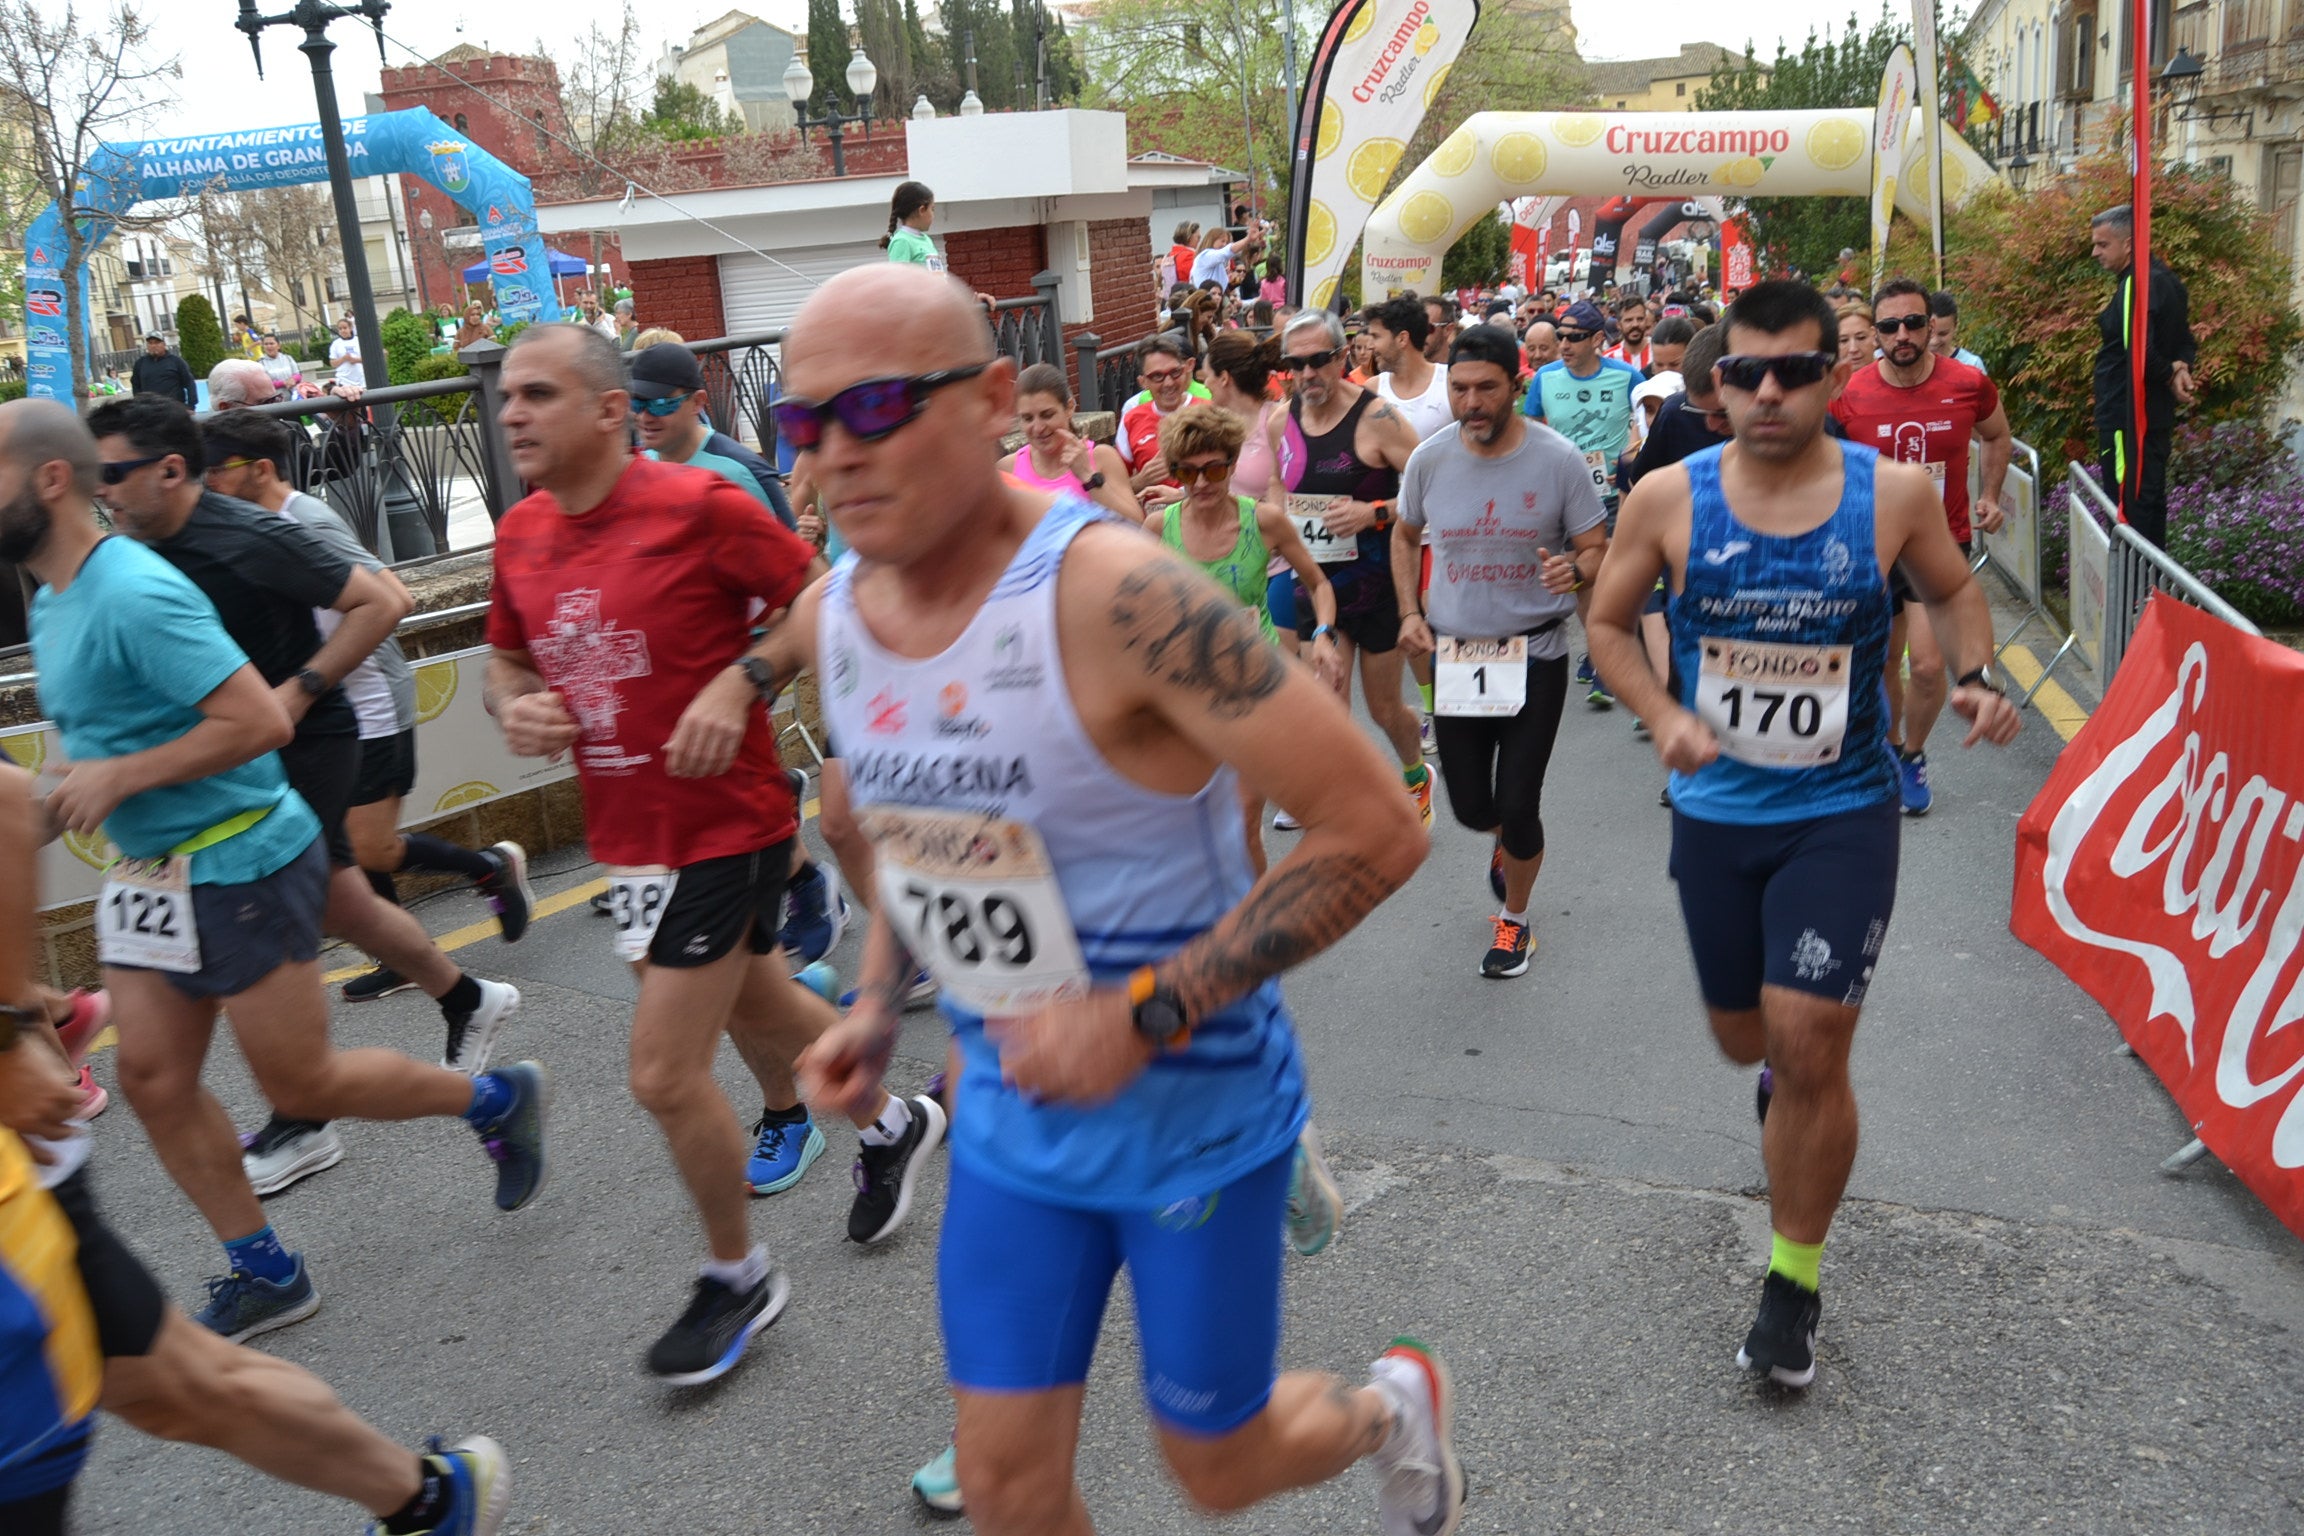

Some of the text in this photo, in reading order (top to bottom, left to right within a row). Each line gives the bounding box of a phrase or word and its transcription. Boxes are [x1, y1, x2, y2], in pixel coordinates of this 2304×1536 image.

[1351, 1, 1430, 104] Cruzcampo
[1380, 56, 1422, 104] Radler
[1606, 124, 1790, 158] Cruzcampo
[142, 140, 369, 179] ALHAMA DE GRANDA
[256, 171, 272, 182] DE
[277, 165, 330, 180] DEPORTE
[1622, 162, 1711, 190] Radler
[1366, 253, 1432, 269] Cruzcampo
[1594, 233, 1617, 253] als
[1473, 666, 1486, 694] 1
[1720, 686, 1820, 737] 170
[108, 888, 179, 938] 122
[903, 882, 1036, 970] 789
